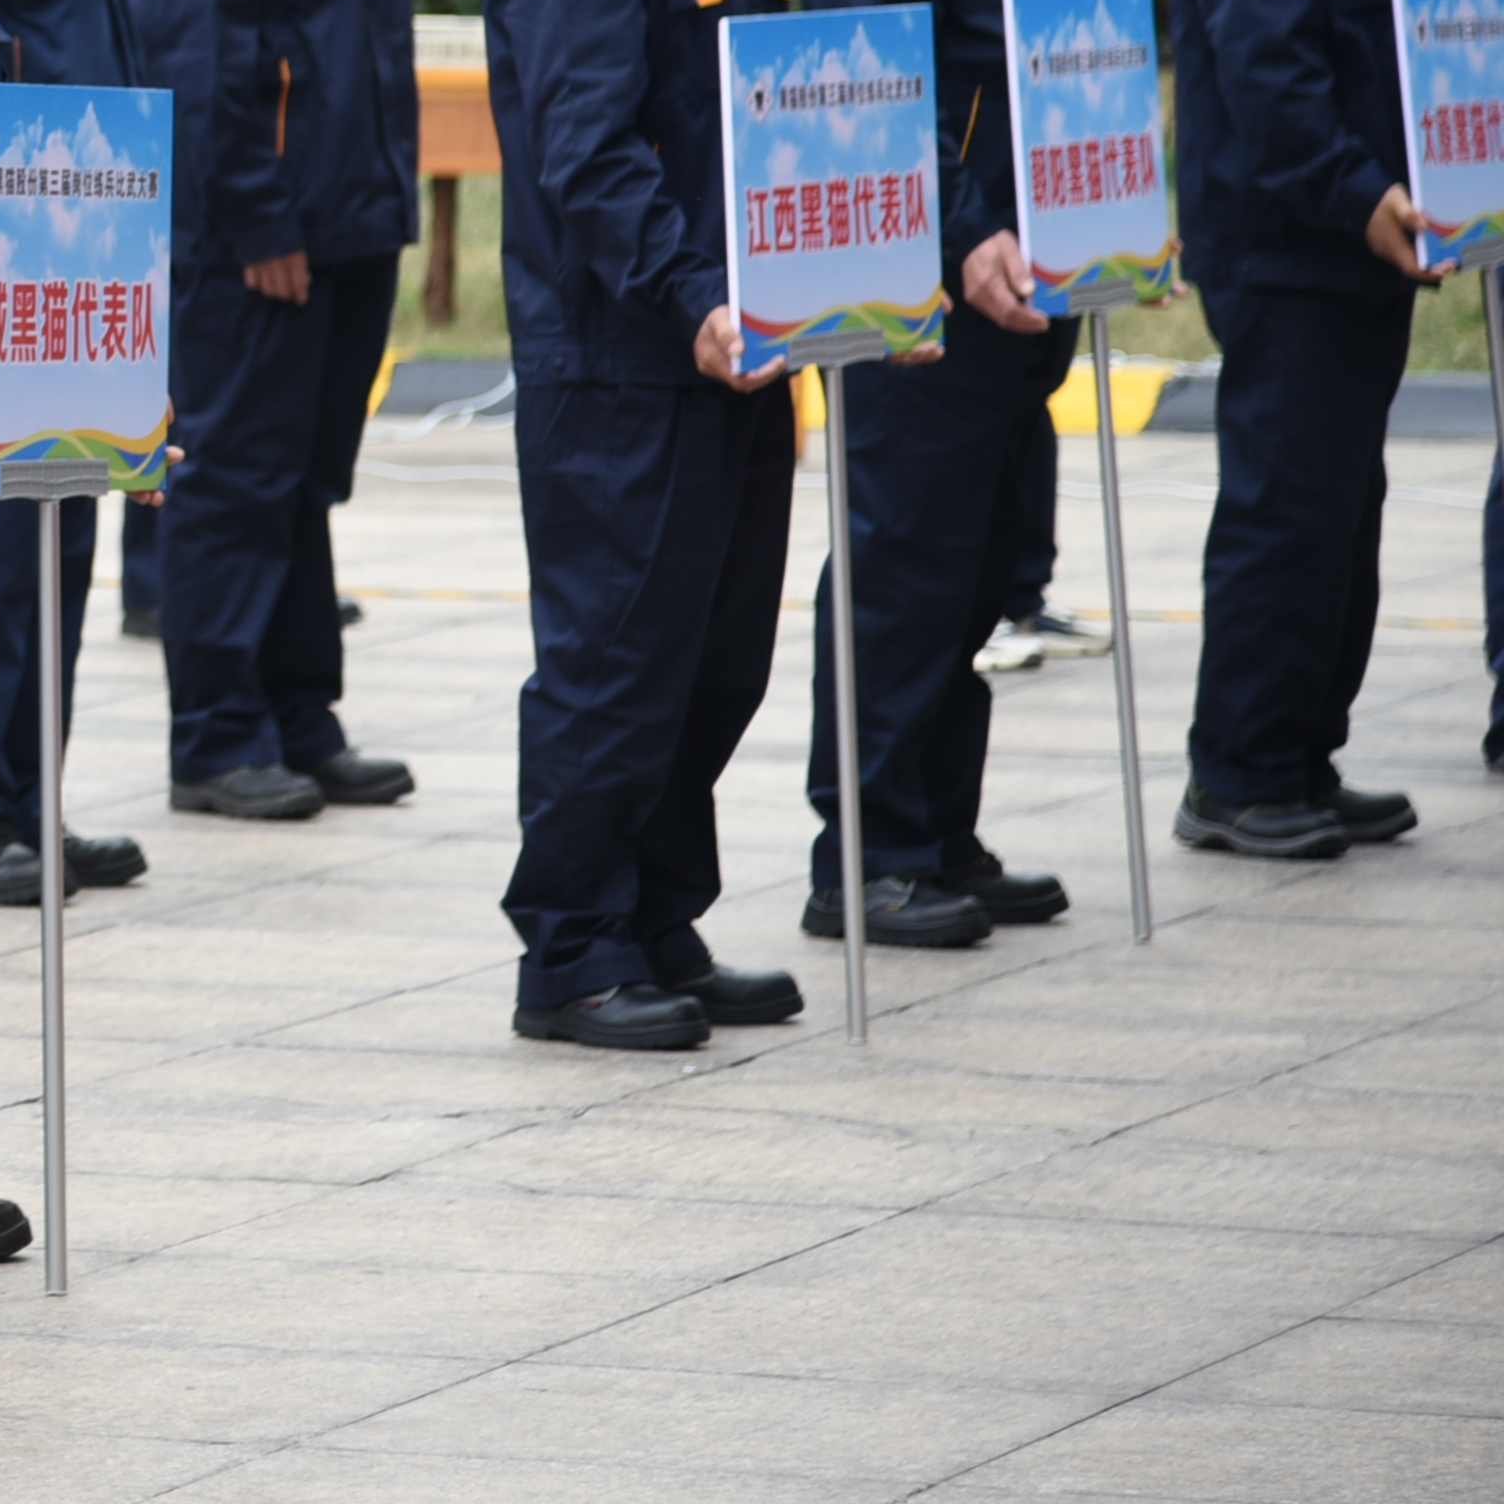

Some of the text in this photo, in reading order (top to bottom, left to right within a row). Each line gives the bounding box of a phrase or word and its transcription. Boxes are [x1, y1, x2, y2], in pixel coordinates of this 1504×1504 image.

[747, 171, 930, 257] 江西黑猫代表队
